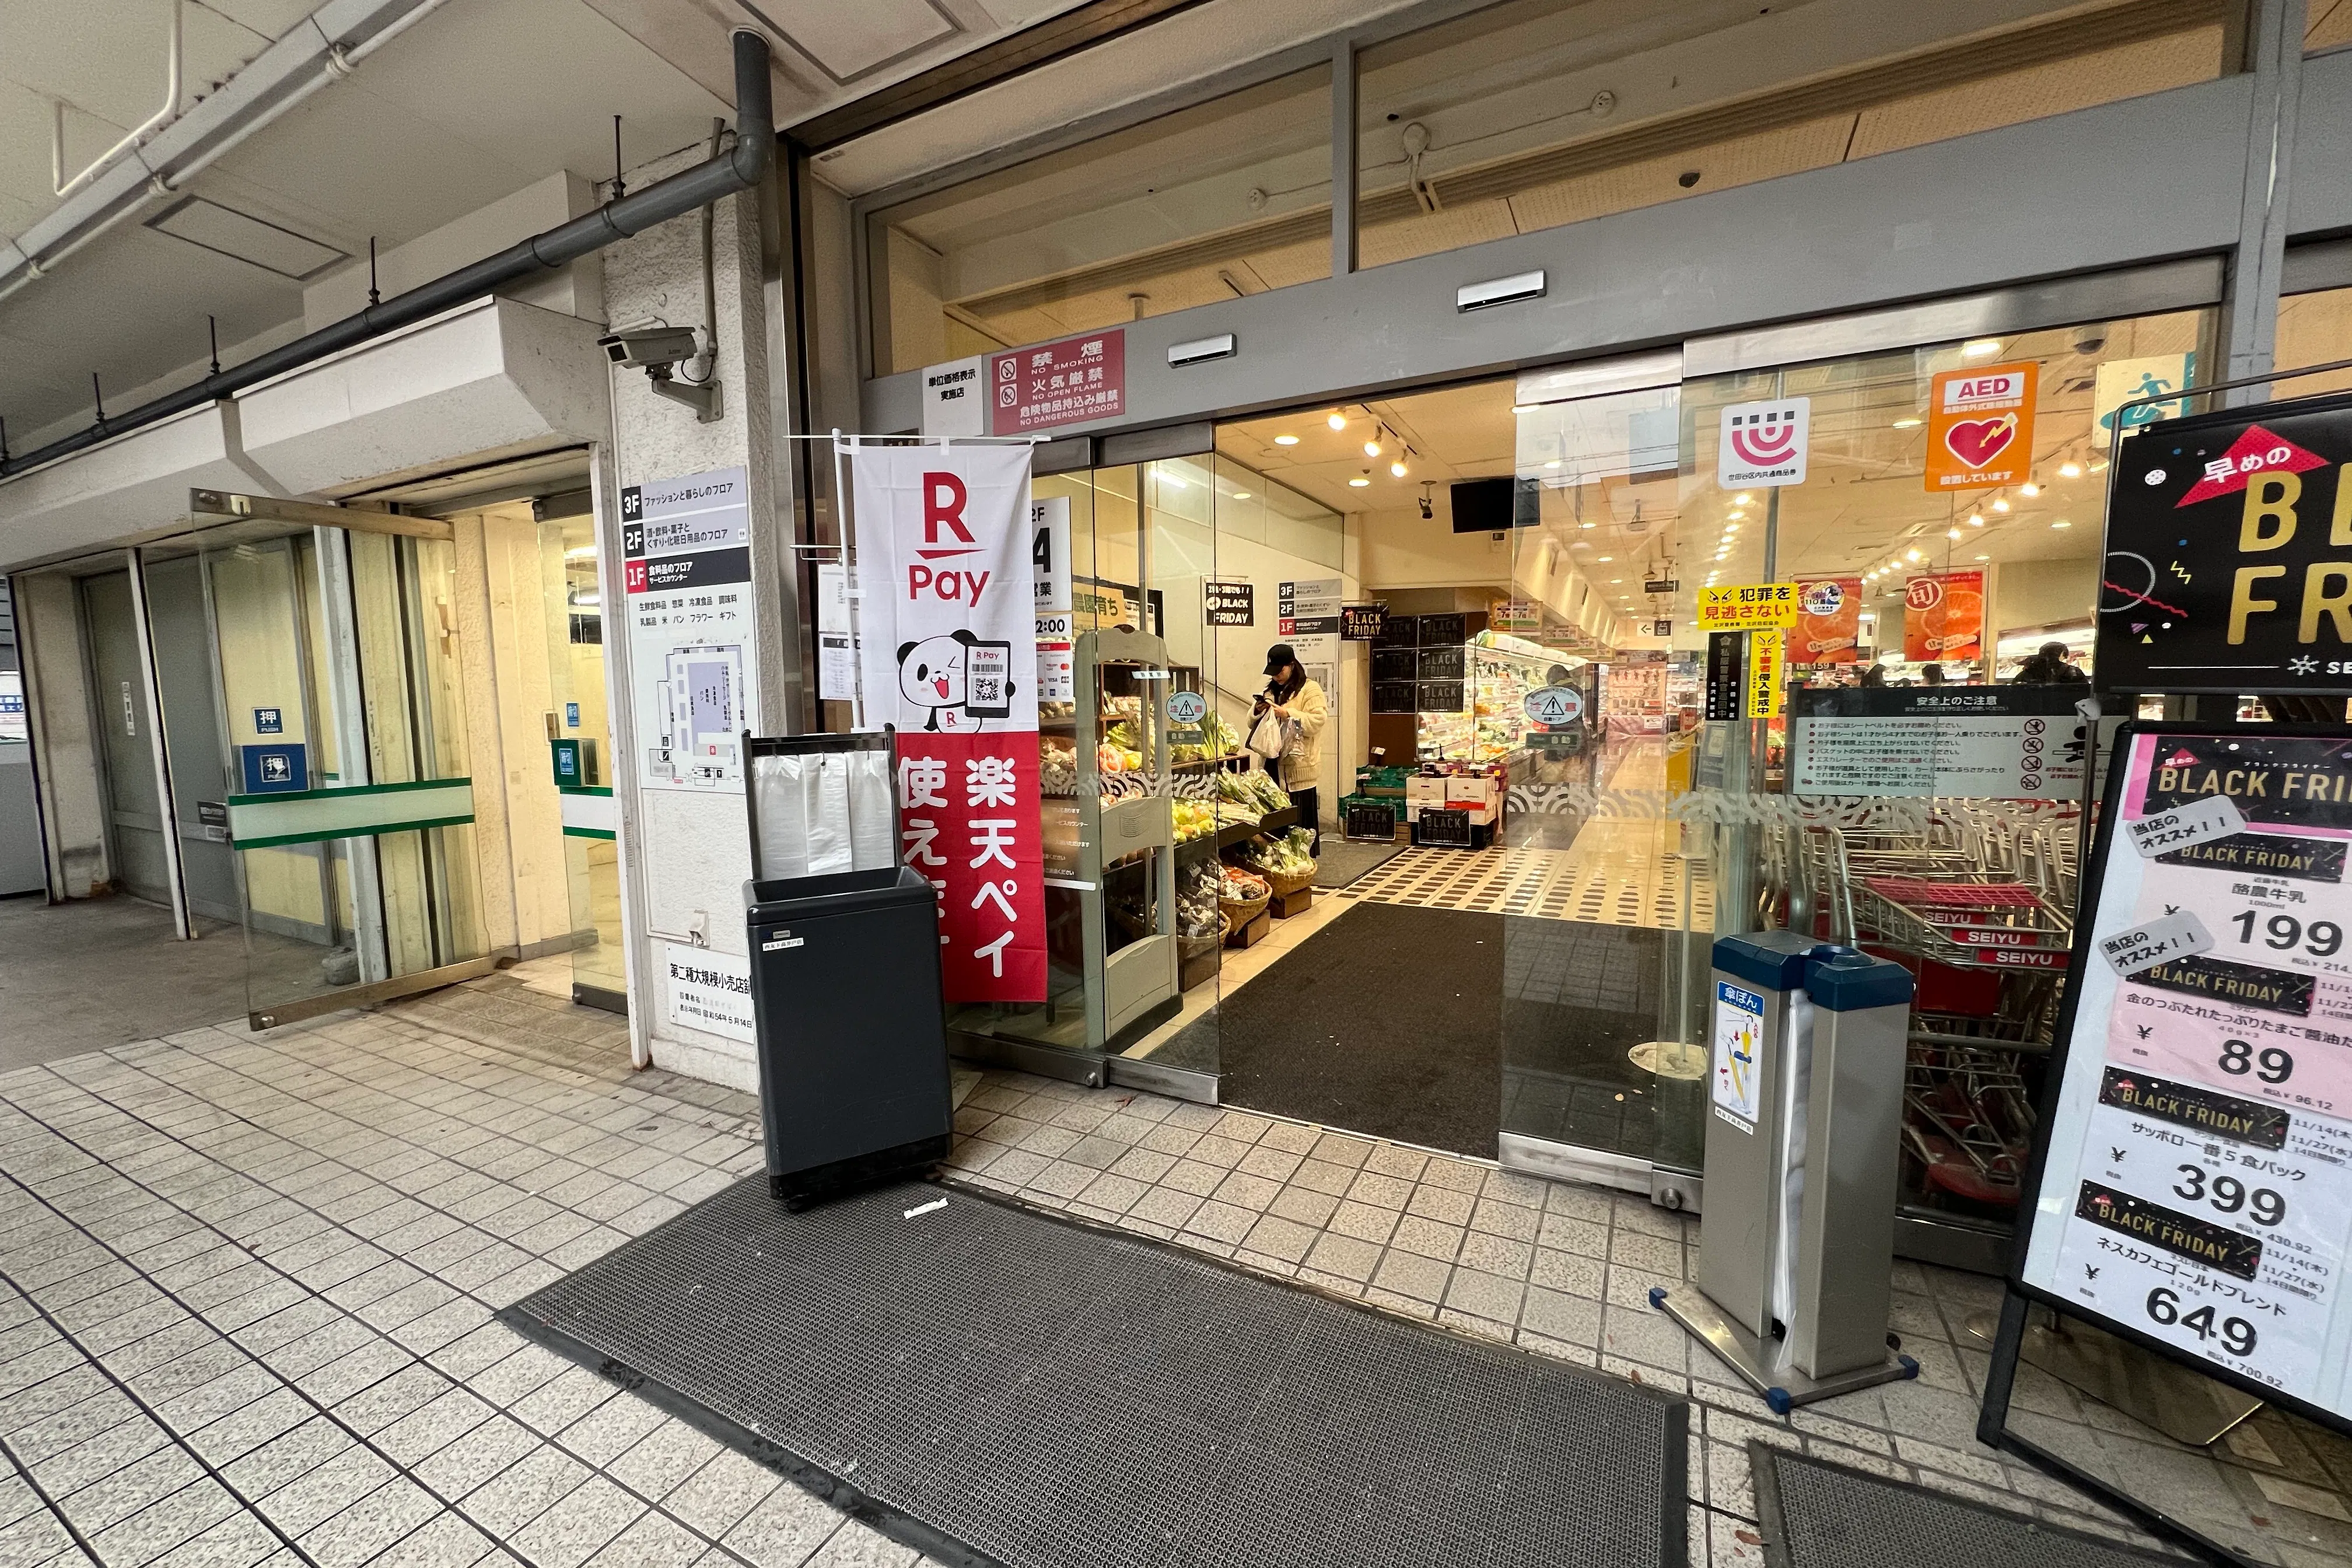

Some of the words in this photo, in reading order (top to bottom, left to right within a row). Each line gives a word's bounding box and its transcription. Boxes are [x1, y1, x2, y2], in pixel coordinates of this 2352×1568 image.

[1054, 355, 1103, 370] SMOKING
[1032, 366, 1103, 393] 火気厳禁
[1958, 378, 2010, 398] AED
[941, 387, 964, 401] 実施店
[1032, 392, 1044, 400] NO
[1048, 388, 1070, 398] OPEN
[1073, 382, 1102, 393] FLAME
[1020, 389, 1118, 418] 危険物品持込み厳禁
[1020, 418, 1031, 426] NO
[1034, 409, 1084, 424] DANGEROUS
[1087, 402, 1118, 414] GOODS
[2204, 446, 2291, 483] 早めの
[624, 494, 639, 514] 3F
[645, 482, 733, 507] ファッションと暮らしのフロア
[923, 472, 976, 542] R
[626, 530, 642, 550] 2F
[629, 567, 645, 586] 1F
[648, 561, 693, 576] 食料品のフロア
[649, 574, 688, 584] サービスカウンター
[909, 565, 990, 608] Pay
[1281, 586, 1293, 596] 3F
[1740, 587, 1790, 603] 犯罪を
[1906, 583, 1934, 605] 旬
[1222, 598, 1248, 608] BLACK
[1281, 604, 1293, 614] 2F
[1704, 604, 1790, 620] 見逃さない
[673, 615, 684, 624] パン
[690, 613, 713, 623] フラワー
[719, 611, 737, 621] ギフト
[1214, 612, 1248, 624] FRIDAY
[1281, 622, 1293, 632] 1F
[1349, 614, 1381, 624] BLACK
[1348, 624, 1381, 635] FRIDAY
[1917, 696, 1997, 706] 安全上のご注意
[259, 710, 276, 724] 押
[947, 712, 957, 724] R
[2158, 767, 2269, 797] BLACK
[2282, 772, 2352, 803] FRI
[2133, 815, 2179, 836] 当店の
[897, 756, 950, 944] 使え
[2180, 845, 2238, 863] BLACK
[2245, 850, 2315, 871] FRIDAY
[965, 755, 1018, 978] 楽天ペイ
[2231, 883, 2306, 904] 酪農牛乳
[1924, 911, 1971, 925] SEIYU
[1968, 932, 2021, 944] SEIYU
[2105, 932, 2148, 954] 当店の
[2232, 909, 2343, 957] 199
[1996, 951, 2053, 965] SEIYU
[2150, 966, 2208, 989] BLACK
[2214, 978, 2282, 1003] FRIDAY
[1724, 986, 1758, 1009] 傘ぽん
[2137, 1024, 2153, 1040] ¥
[2218, 1040, 2293, 1084] 89
[2122, 1087, 2178, 1115] BLACK
[2186, 1104, 2253, 1135] FRIDAY
[2295, 1095, 2333, 1110] 96.12
[2111, 1146, 2127, 1163] ¥
[2172, 1164, 2286, 1226] 399
[2098, 1204, 2155, 1237] BLACK
[2161, 1226, 2229, 1262] FRIDAY
[2096, 1236, 2287, 1317] ネスカフェゴールドブレンド
[2084, 1263, 2101, 1279] ¥
[2146, 1287, 2258, 1357] 649
[2238, 1362, 2283, 1388] 700.92
